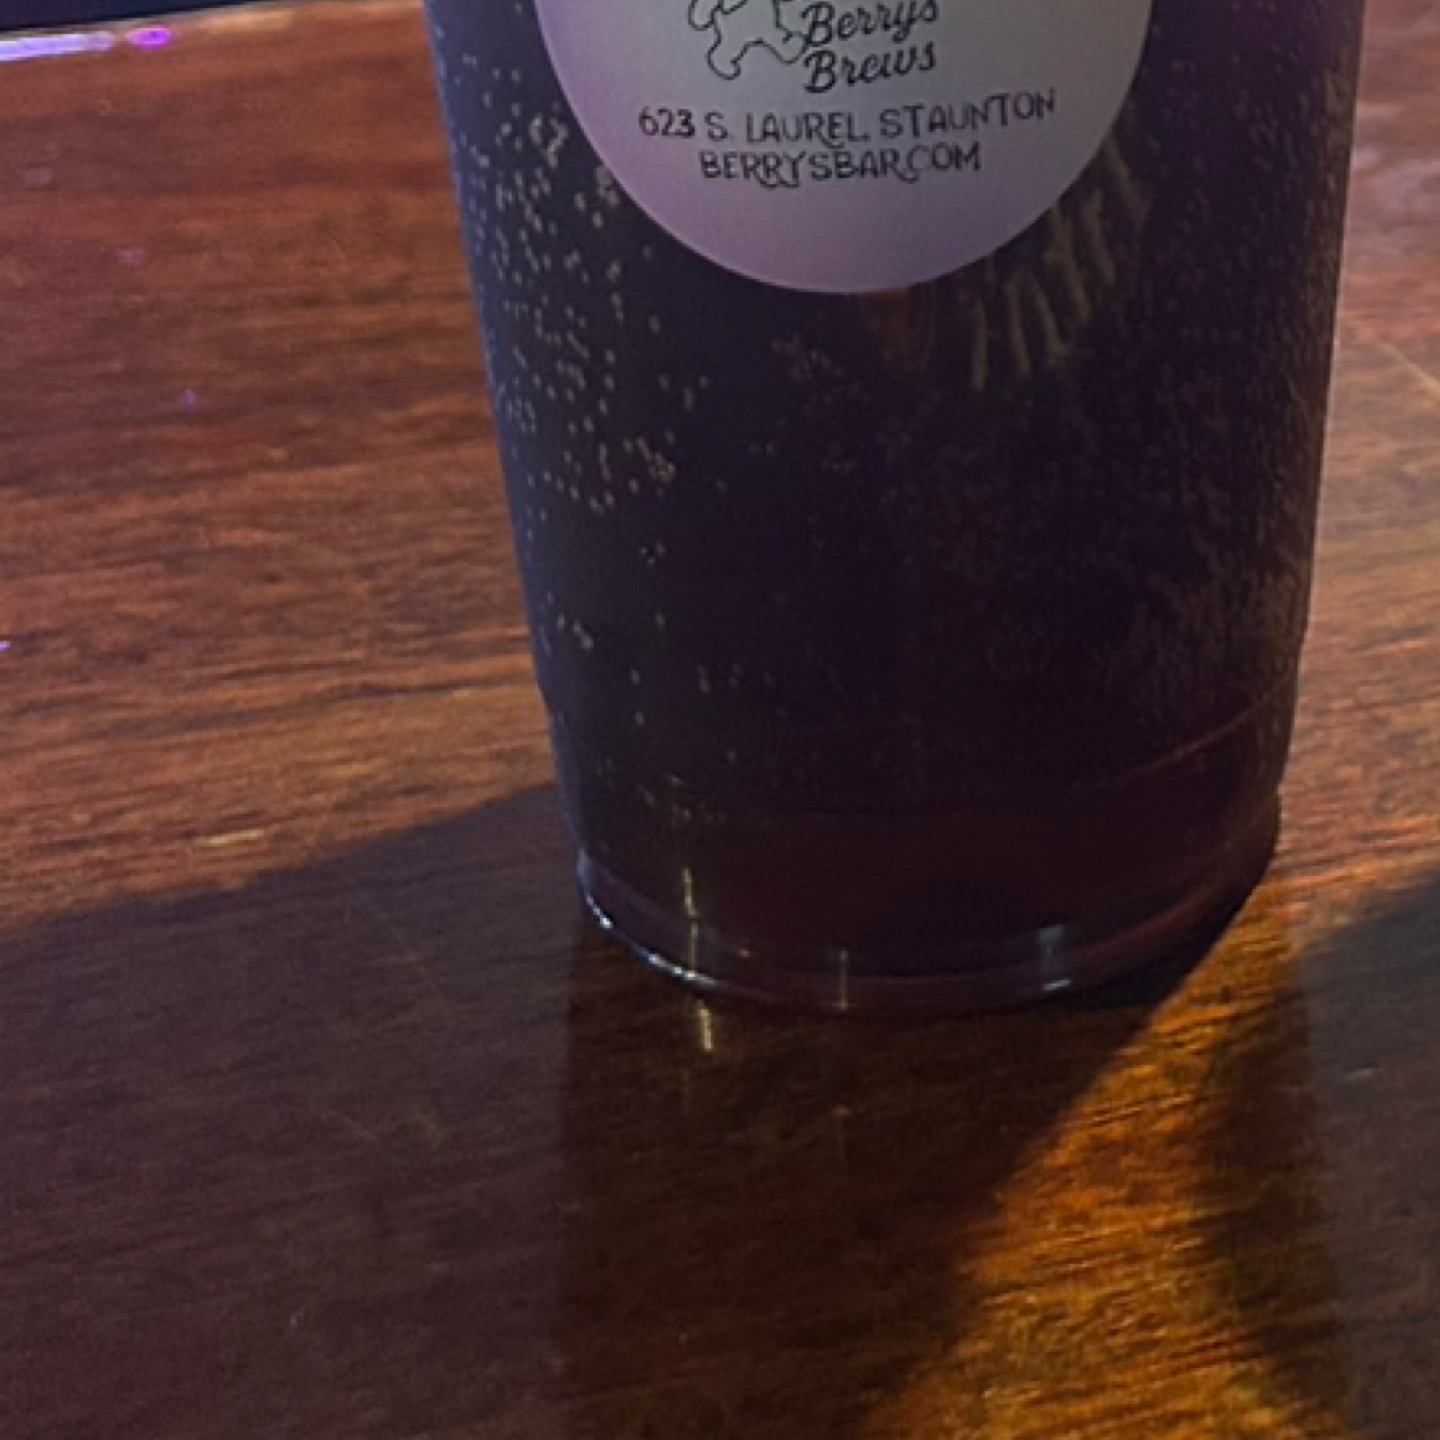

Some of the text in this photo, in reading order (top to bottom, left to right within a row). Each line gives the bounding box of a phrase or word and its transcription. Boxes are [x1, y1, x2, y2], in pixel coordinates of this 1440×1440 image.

[803, 42, 938, 94] Brews
[638, 107, 696, 139] 623
[880, 89, 1057, 135] STAUNTON
